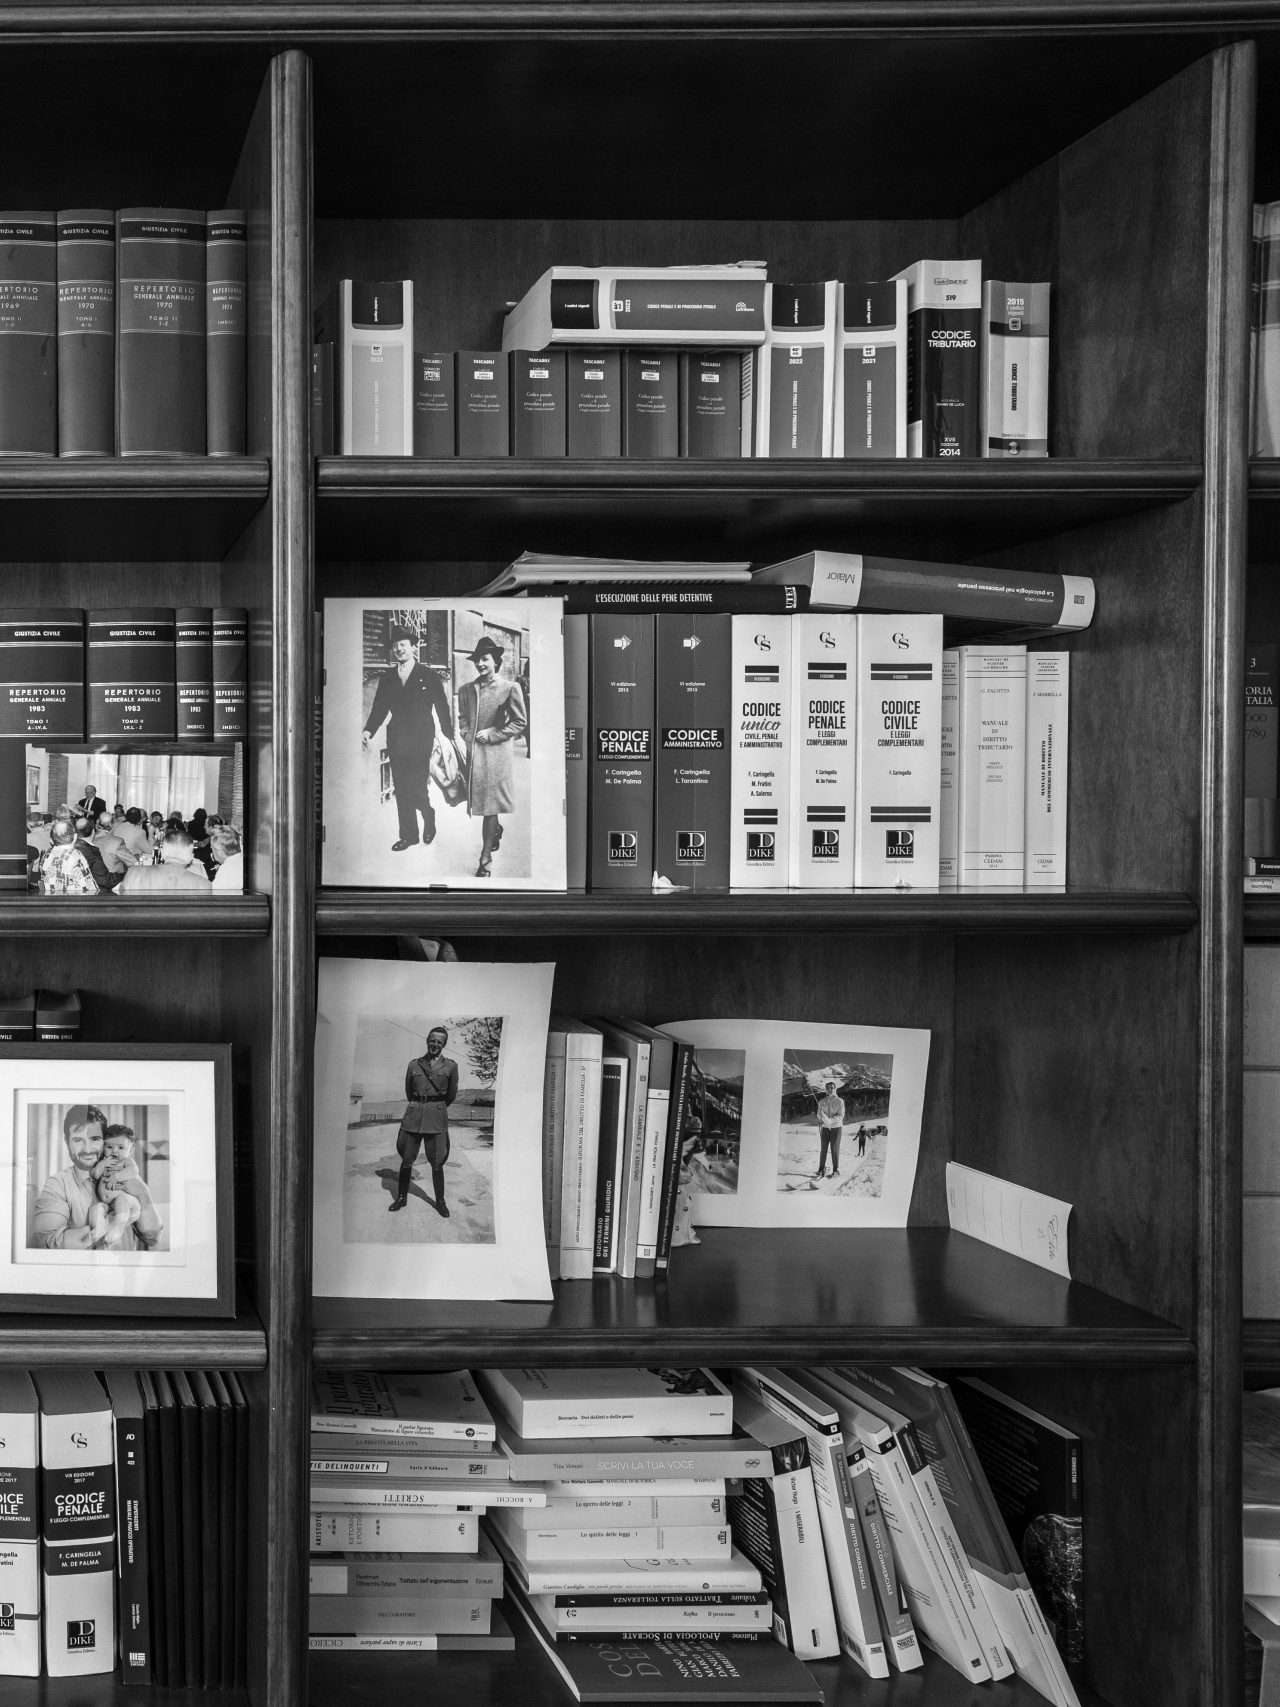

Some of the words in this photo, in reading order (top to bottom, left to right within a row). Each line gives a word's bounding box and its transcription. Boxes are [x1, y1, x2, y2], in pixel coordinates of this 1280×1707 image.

[931, 330, 971, 339] CODICE
[927, 339, 976, 348] TRIBUTARIO
[939, 448, 961, 456] 2014
[826, 571, 856, 584] Maior
[595, 593, 641, 604] L'ESECUZIONE
[642, 593, 660, 603] DELLE
[662, 593, 678, 603] PENE
[679, 593, 713, 604] DETENTIVE
[1245, 686, 1272, 696] ORIA
[1246, 696, 1273, 705] TALIA
[742, 703, 781, 717] CODICE
[809, 700, 846, 714] CODICE
[881, 700, 921, 714] CODICE
[740, 718, 781, 732] unico
[808, 715, 846, 729] PENALE
[884, 716, 918, 730] CIVILE
[599, 730, 650, 741] CODICE
[667, 729, 718, 740] CODICE
[663, 740, 723, 748] AMMINISTRATIVO
[806, 738, 848, 746] COMPLEMENTARI
[877, 739, 924, 747] COMPLEMENTARI
[601, 742, 647, 753] PENALE
[611, 848, 636, 857] DIKE
[679, 848, 704, 857] DIKE
[748, 848, 775, 857] DIKE
[813, 846, 837, 855] DIKE
[887, 846, 912, 855] DIKE
[325, 1462, 379, 1472] DELINQUENTI
[54, 1491, 105, 1505] CODICE
[384, 1494, 425, 1503] SCRITTI
[57, 1503, 103, 1515] PENALE
[67, 1514, 109, 1523] COMPLEMENTARI
[80, 1559, 99, 1567] PALMA
[69, 1636, 93, 1646] DIKE
[622, 1632, 661, 1641] SOCRATE
[676, 1632, 721, 1641] APOLOGIA
